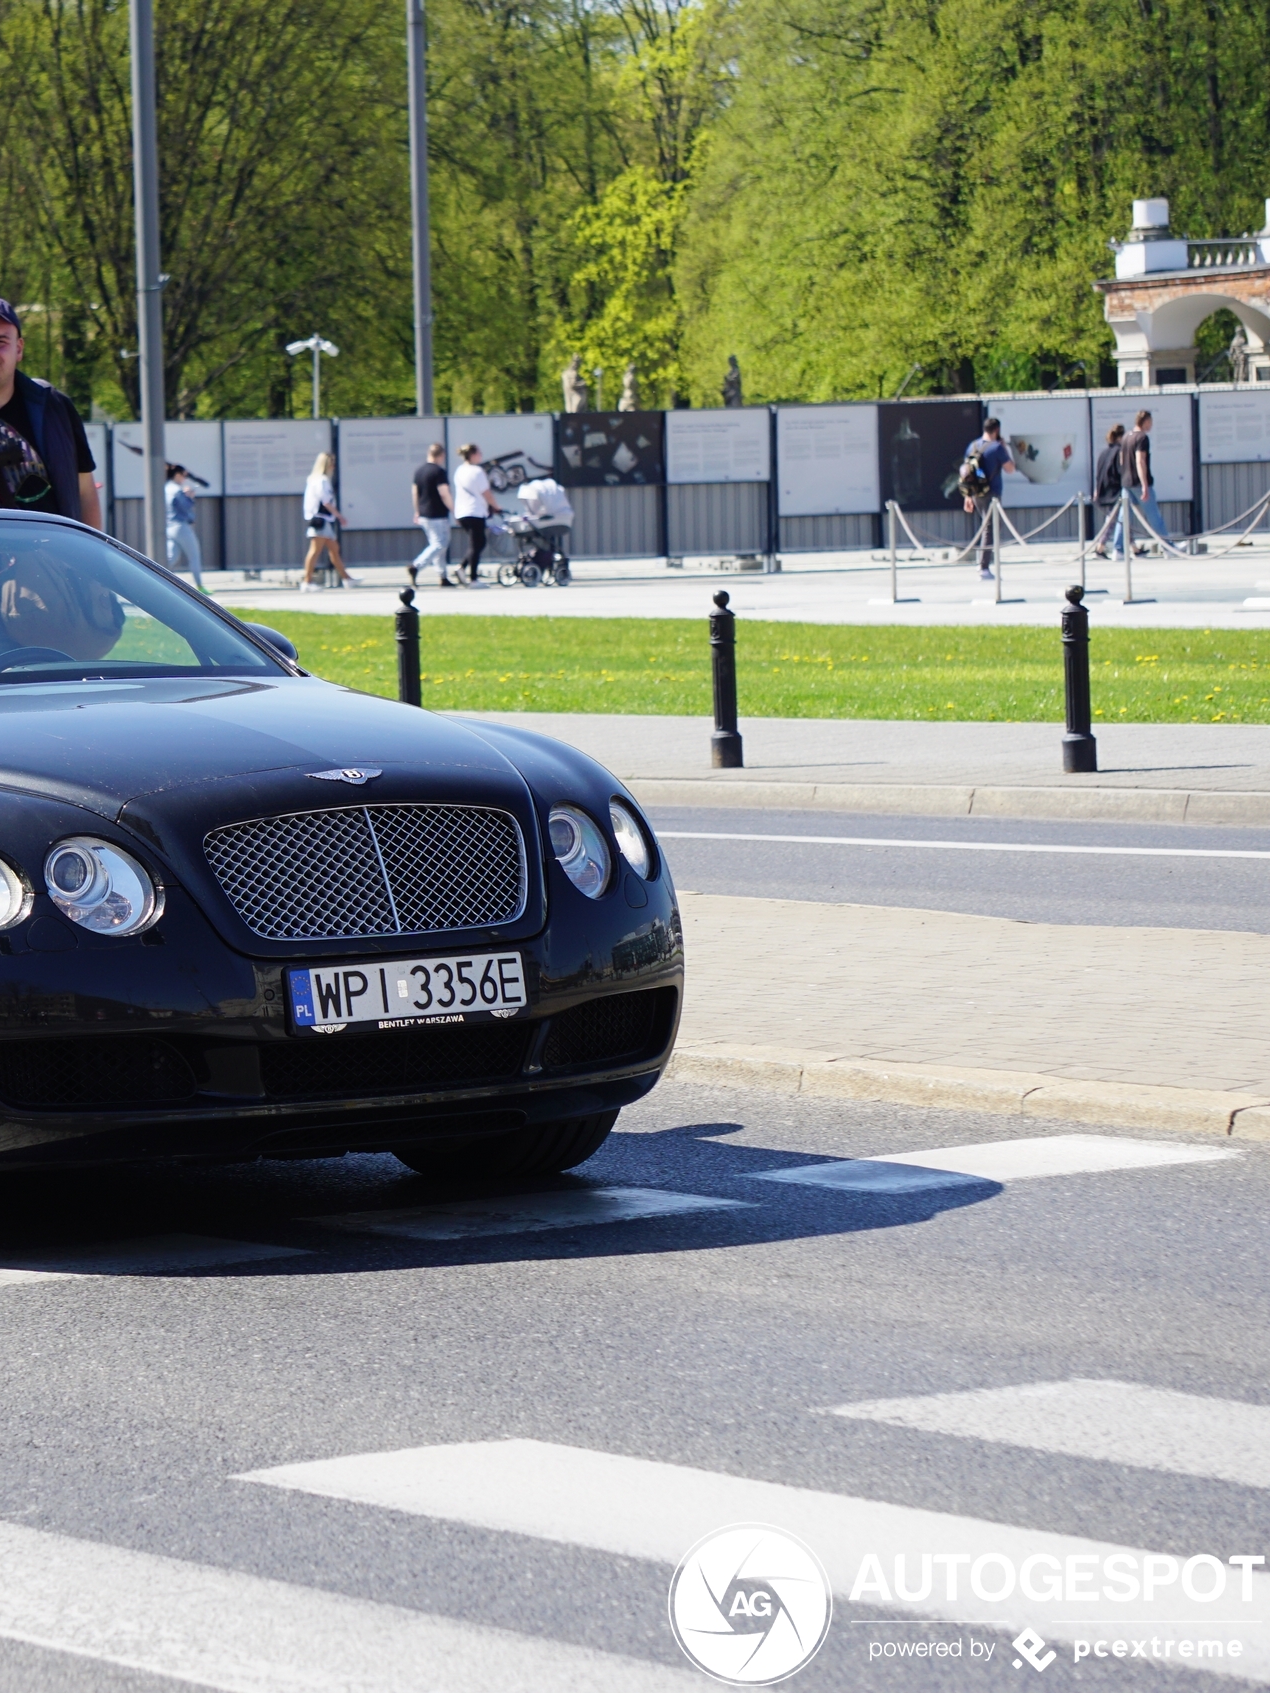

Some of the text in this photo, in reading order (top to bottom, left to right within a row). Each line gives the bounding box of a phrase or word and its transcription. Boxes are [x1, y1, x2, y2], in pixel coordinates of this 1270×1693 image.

[410, 957, 522, 1010] 3356E
[296, 1005, 312, 1018] PL
[378, 1014, 464, 1029] BENTLEY WARSZAWA
